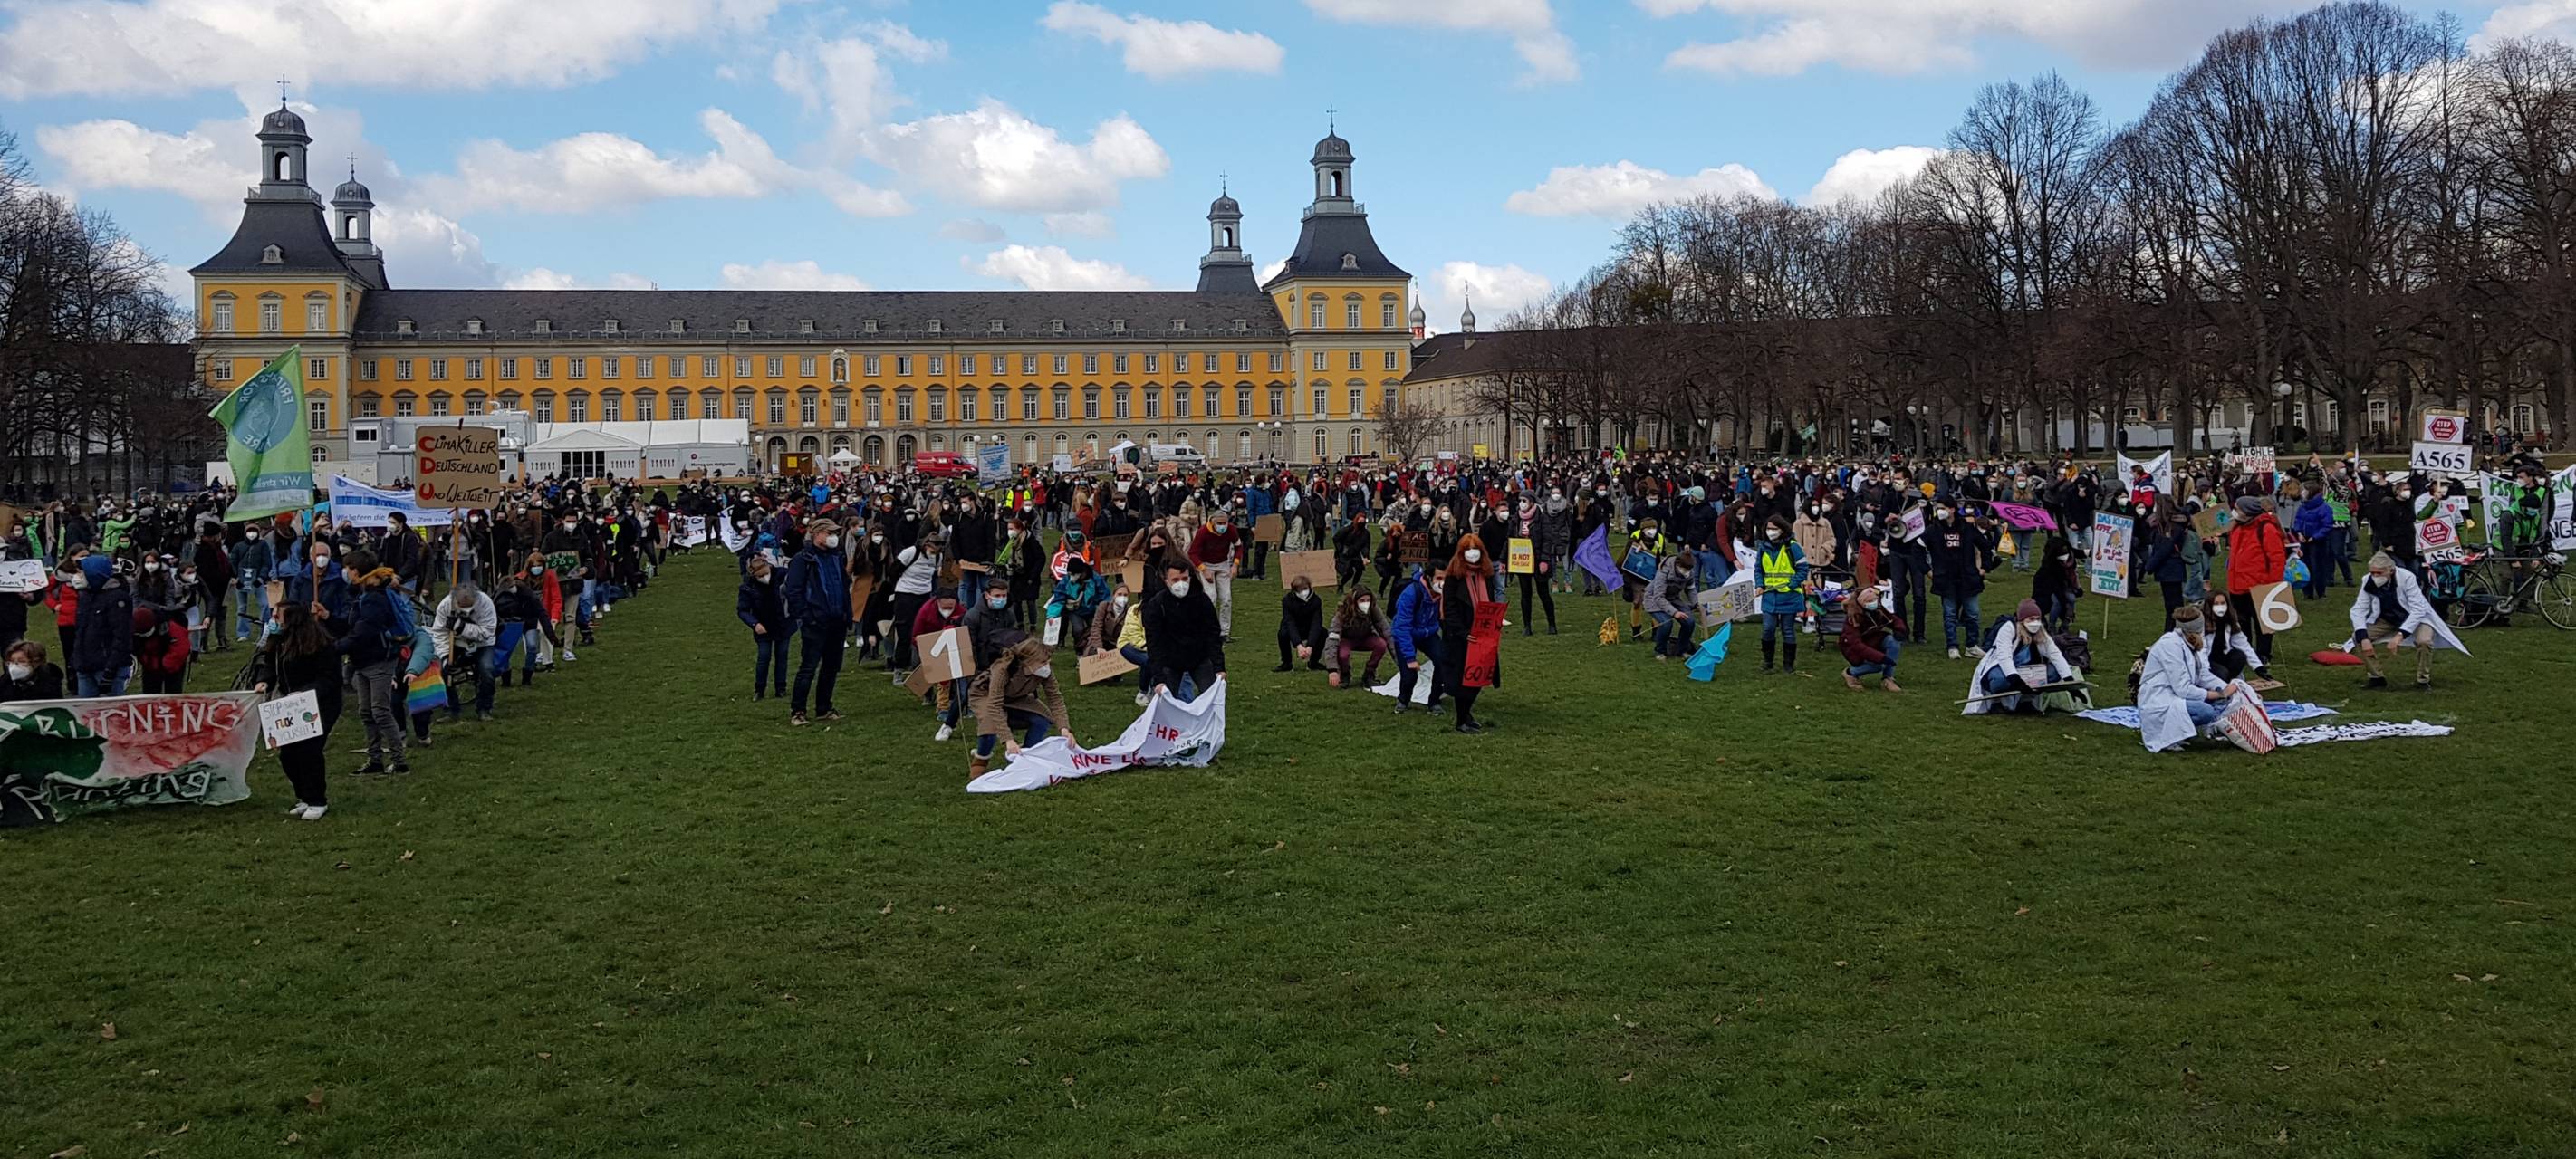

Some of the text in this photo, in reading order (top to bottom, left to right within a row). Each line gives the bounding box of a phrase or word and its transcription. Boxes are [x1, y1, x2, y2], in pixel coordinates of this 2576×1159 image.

[420, 457, 498, 474] DEUTSCHLAND
[2413, 450, 2465, 470] A565
[419, 483, 445, 501] UND
[373, 512, 385, 522] die
[2427, 524, 2443, 533] STOP
[2429, 547, 2464, 562] A565
[2260, 581, 2299, 631] 6
[930, 627, 964, 679] 1
